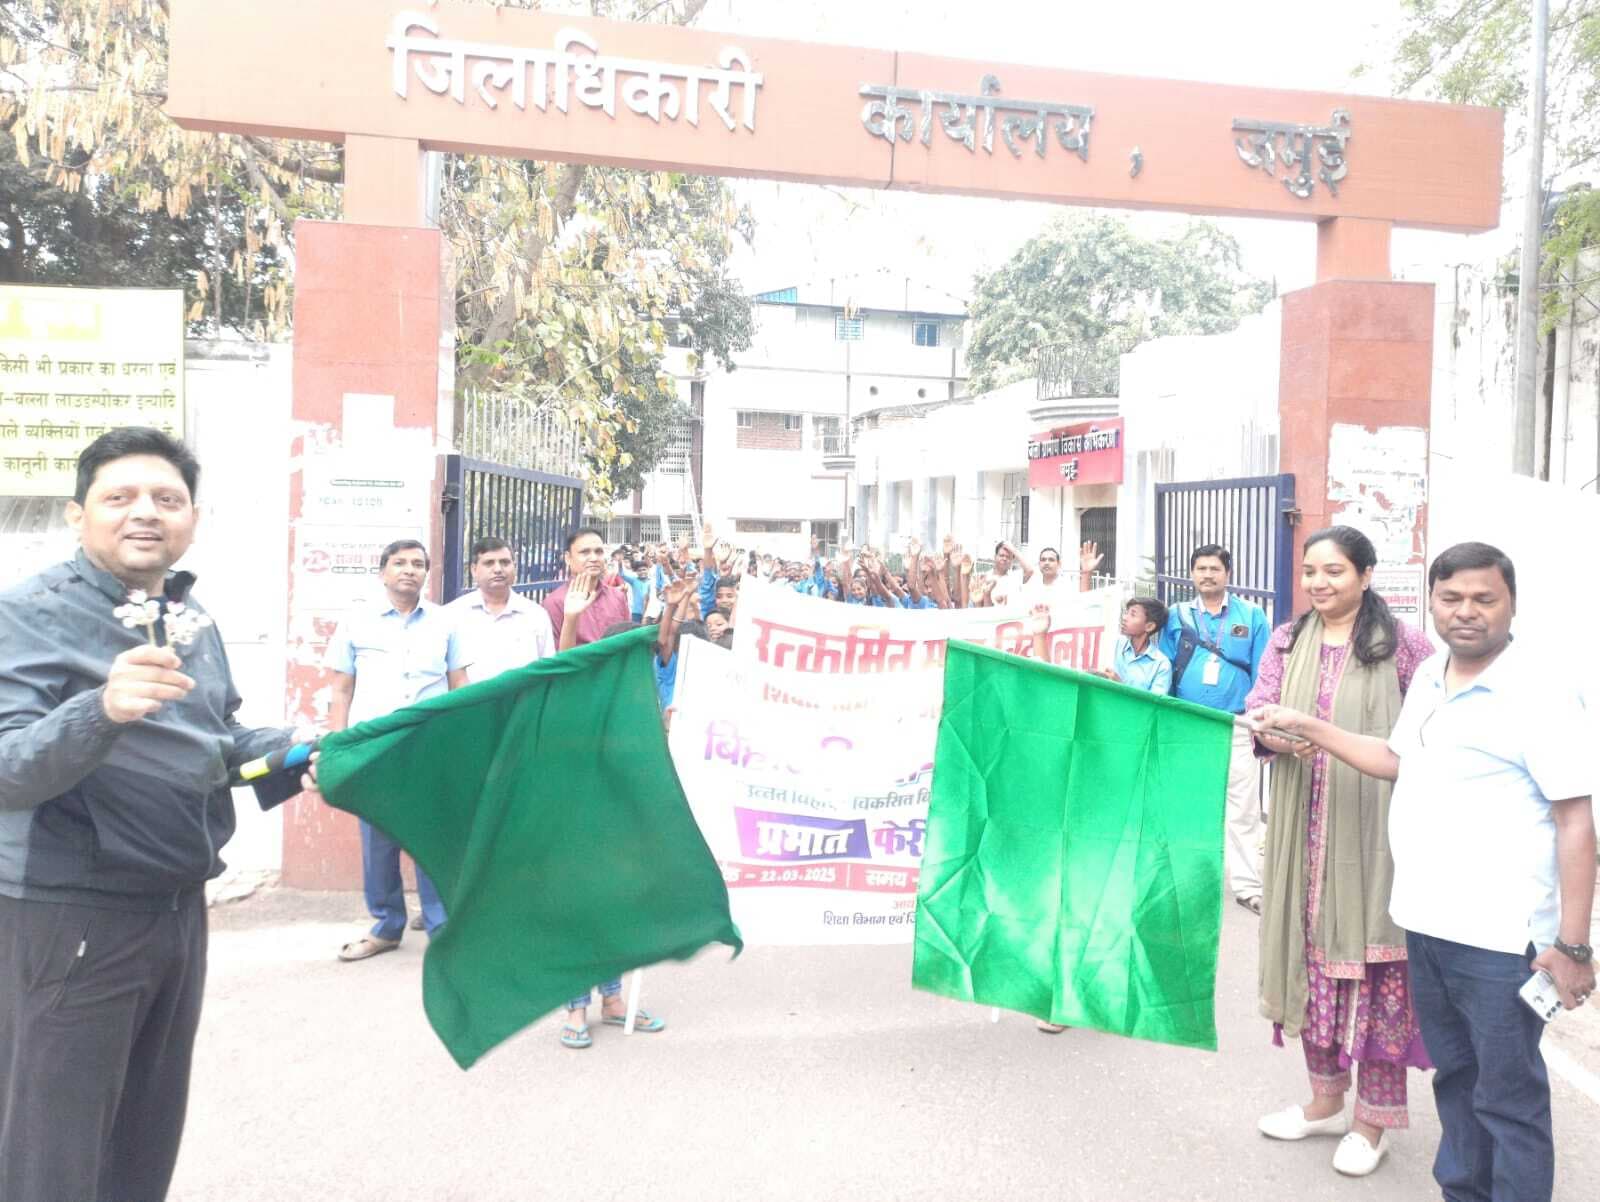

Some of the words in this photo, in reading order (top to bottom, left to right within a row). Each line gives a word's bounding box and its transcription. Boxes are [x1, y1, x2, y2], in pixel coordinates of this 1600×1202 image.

[386, 10, 763, 132] जिलाधिकारी
[859, 74, 1095, 161] कार्यालय
[1231, 107, 1351, 197] जमुई
[36, 353, 52, 374] भी
[58, 361, 94, 376] प्रकार
[99, 361, 116, 376] का
[756, 820, 855, 857] प्रभात
[759, 867, 836, 883] 22.03.2025
[864, 869, 908, 887] समय
